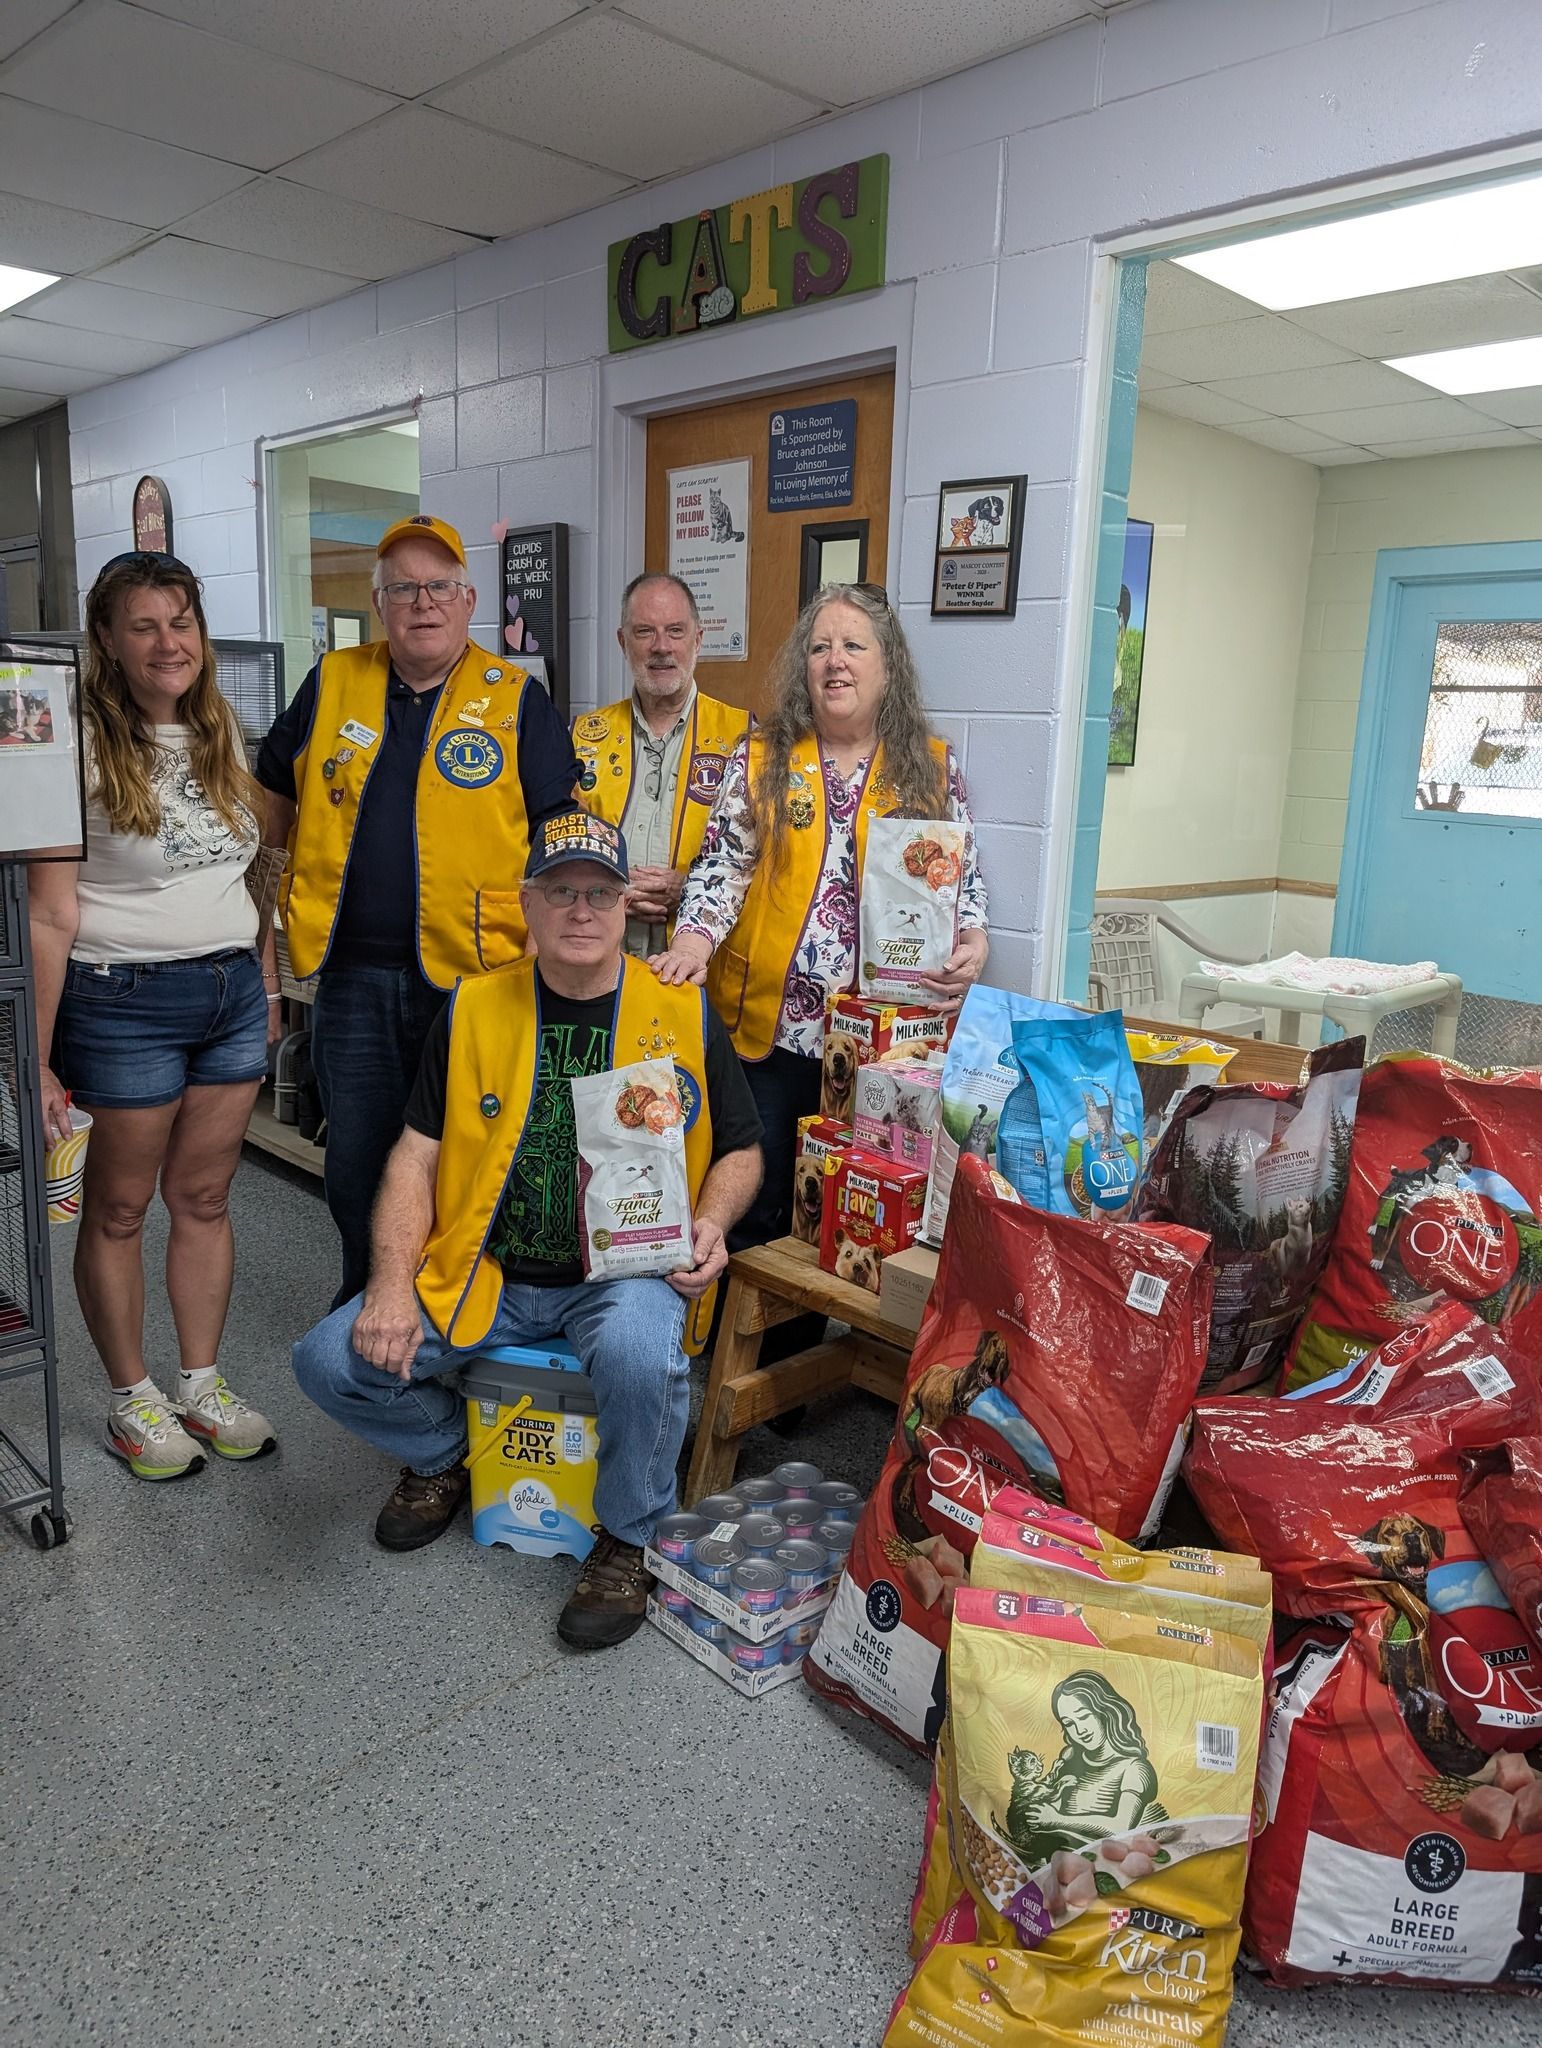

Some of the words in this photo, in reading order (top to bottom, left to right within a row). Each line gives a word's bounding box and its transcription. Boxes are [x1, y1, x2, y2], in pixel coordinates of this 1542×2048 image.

[617, 162, 859, 340] CATS
[792, 419, 807, 430] This
[809, 416, 833, 428] Room
[781, 435, 787, 446] is
[789, 428, 831, 446] Sponsored
[832, 428, 843, 440] by
[777, 449, 799, 460] Bruce
[800, 445, 816, 457] and
[817, 441, 847, 454] Debbie
[794, 459, 828, 471] Johnson
[774, 480, 782, 491] In
[783, 477, 807, 491] Loving
[808, 474, 839, 487] Memory
[840, 470, 848, 483] of
[676, 494, 702, 508] PLEASE
[676, 510, 705, 524] FOLLOW
[676, 528, 687, 540] MY
[688, 525, 710, 539] RULES
[513, 542, 542, 555] CUPIDS
[507, 557, 533, 571] CRUSH
[535, 558, 549, 570] OF
[506, 573, 522, 585] THE
[524, 570, 552, 584] WEEK:
[523, 588, 543, 600] PRU
[971, 599, 994, 607] Snyder
[452, 734, 487, 745] LIONS
[463, 746, 480, 764] L
[694, 759, 720, 768] LIONS
[700, 769, 716, 786] L
[544, 814, 586, 833] COAST
[544, 825, 586, 844] GUARD
[544, 837, 619, 865] RETIRED
[876, 938, 924, 957] Fancy
[883, 951, 922, 967] Feast
[882, 1010, 888, 1018] 4
[1000, 1052, 1018, 1066] ON
[830, 1161, 838, 1170] 7
[1271, 1150, 1310, 1165] NUTRITION
[1090, 1159, 1133, 1187] ONE
[607, 1196, 663, 1215] Fancy
[616, 1209, 663, 1229] Feast
[1457, 1219, 1501, 1236] PURINA
[1410, 1221, 1502, 1273] ONE
[1343, 1343, 1368, 1357] LAM
[1363, 1374, 1384, 1403] LARGE
[515, 1418, 553, 1431] PURINA
[504, 1428, 554, 1449] TIDY
[565, 1431, 582, 1443] 10
[502, 1444, 556, 1466] CATS
[927, 1447, 1031, 1508] ON
[514, 1489, 551, 1511] glade
[943, 1504, 975, 1526] +PLUS
[1022, 1530, 1040, 1546] 13
[1171, 1561, 1214, 1574] PURINA
[871, 1585, 899, 1616] VETERINARIAN
[998, 1600, 1018, 1616] 13
[868, 1600, 895, 1627] RECOMMENDED
[856, 1623, 893, 1661] LARGE
[1160, 1627, 1202, 1643] PURINA
[853, 1638, 888, 1676] BREED
[1483, 1649, 1527, 1666] RINA
[840, 1645, 862, 1666] ADULT
[862, 1664, 897, 1696] FORMULA
[835, 1661, 860, 1686] SPECIALLY
[861, 1682, 898, 1713] FORMULATED
[1499, 1713, 1537, 1725] +PLUS
[1413, 1839, 1459, 1866] VETERINARIAN
[1411, 1864, 1456, 1888] RECOMMENDED
[1022, 1897, 1042, 1916] CHICKEN
[1393, 1897, 1459, 1921] LARGE
[944, 1909, 959, 1943] nouris
[1020, 1913, 1043, 1937] INGREDIENT
[1130, 1910, 1204, 1940] PURI
[1391, 1918, 1455, 1941] BREED
[1367, 1933, 1409, 1950] ADULT
[1412, 1941, 1468, 1954] FORMULA
[1095, 1929, 1207, 1984] Kitten
[1358, 1955, 1405, 1966] SPECIALLY
[1144, 1970, 1207, 2003] Chow
[952, 2003, 981, 2025] Developing
[975, 2004, 995, 2018] Protein
[1104, 2000, 1203, 2037] naturals
[908, 2019, 920, 2031] NET
[932, 2032, 941, 2045] LB
[927, 2013, 952, 2032] Complete
[953, 2027, 958, 2035] &
[1082, 2018, 1109, 2031] with
[1110, 2023, 1149, 2040] added
